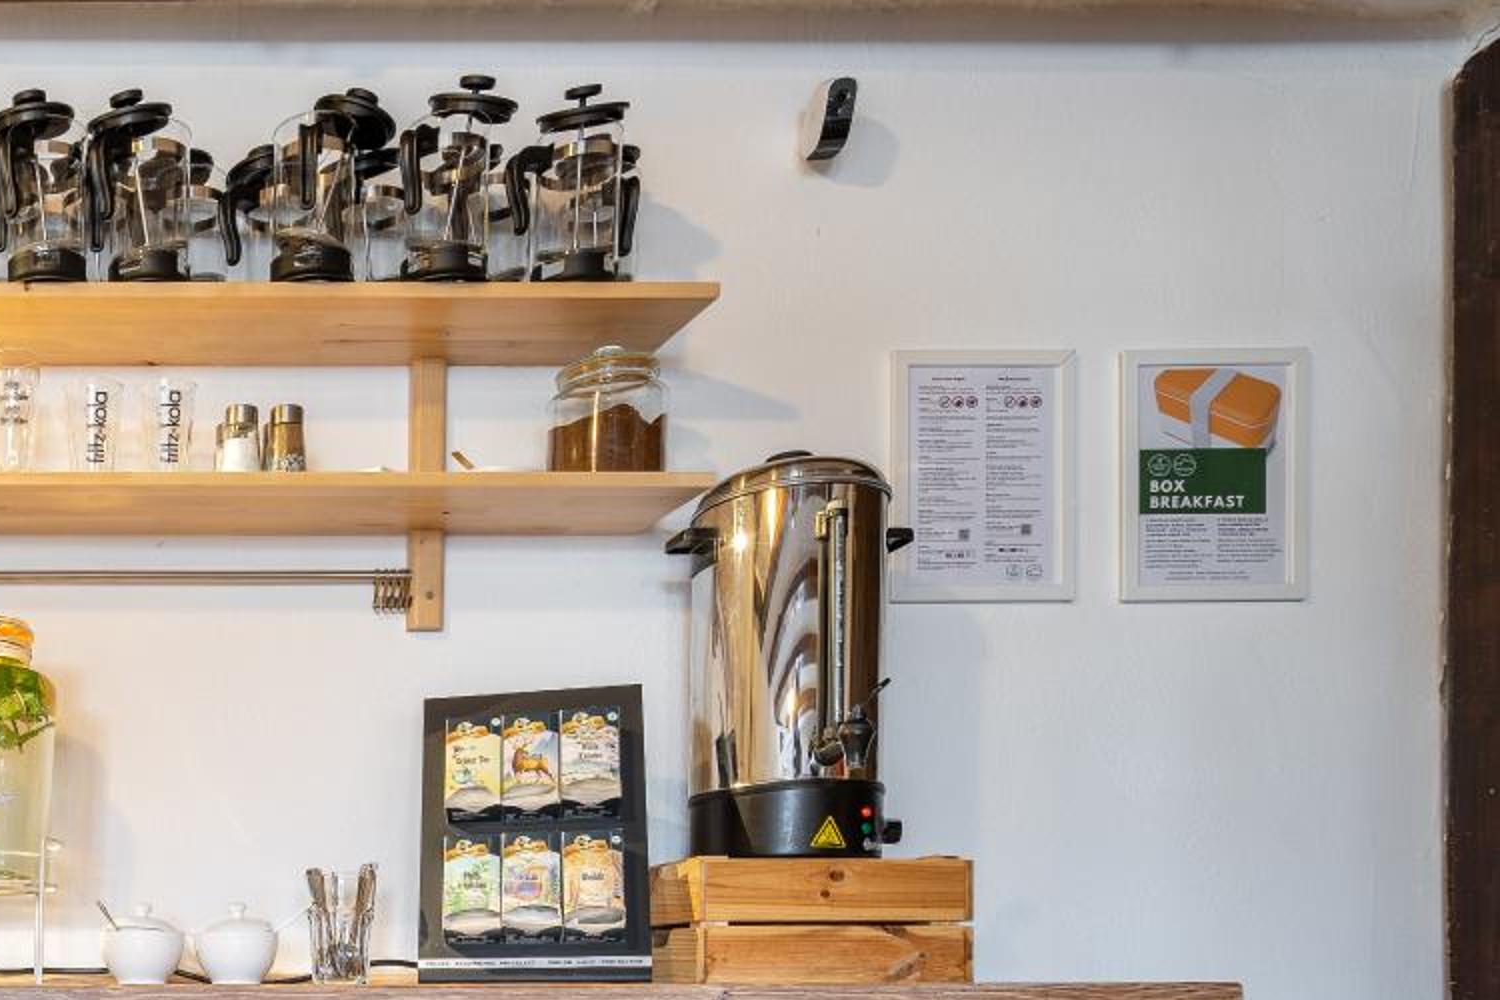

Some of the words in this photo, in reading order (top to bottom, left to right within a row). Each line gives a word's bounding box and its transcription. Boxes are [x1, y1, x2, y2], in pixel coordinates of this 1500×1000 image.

[86, 391, 108, 463] fritz-kola
[159, 389, 182, 463] fritz-kola
[1149, 480, 1186, 493] BOX
[1149, 495, 1245, 509] BREAKFAST
